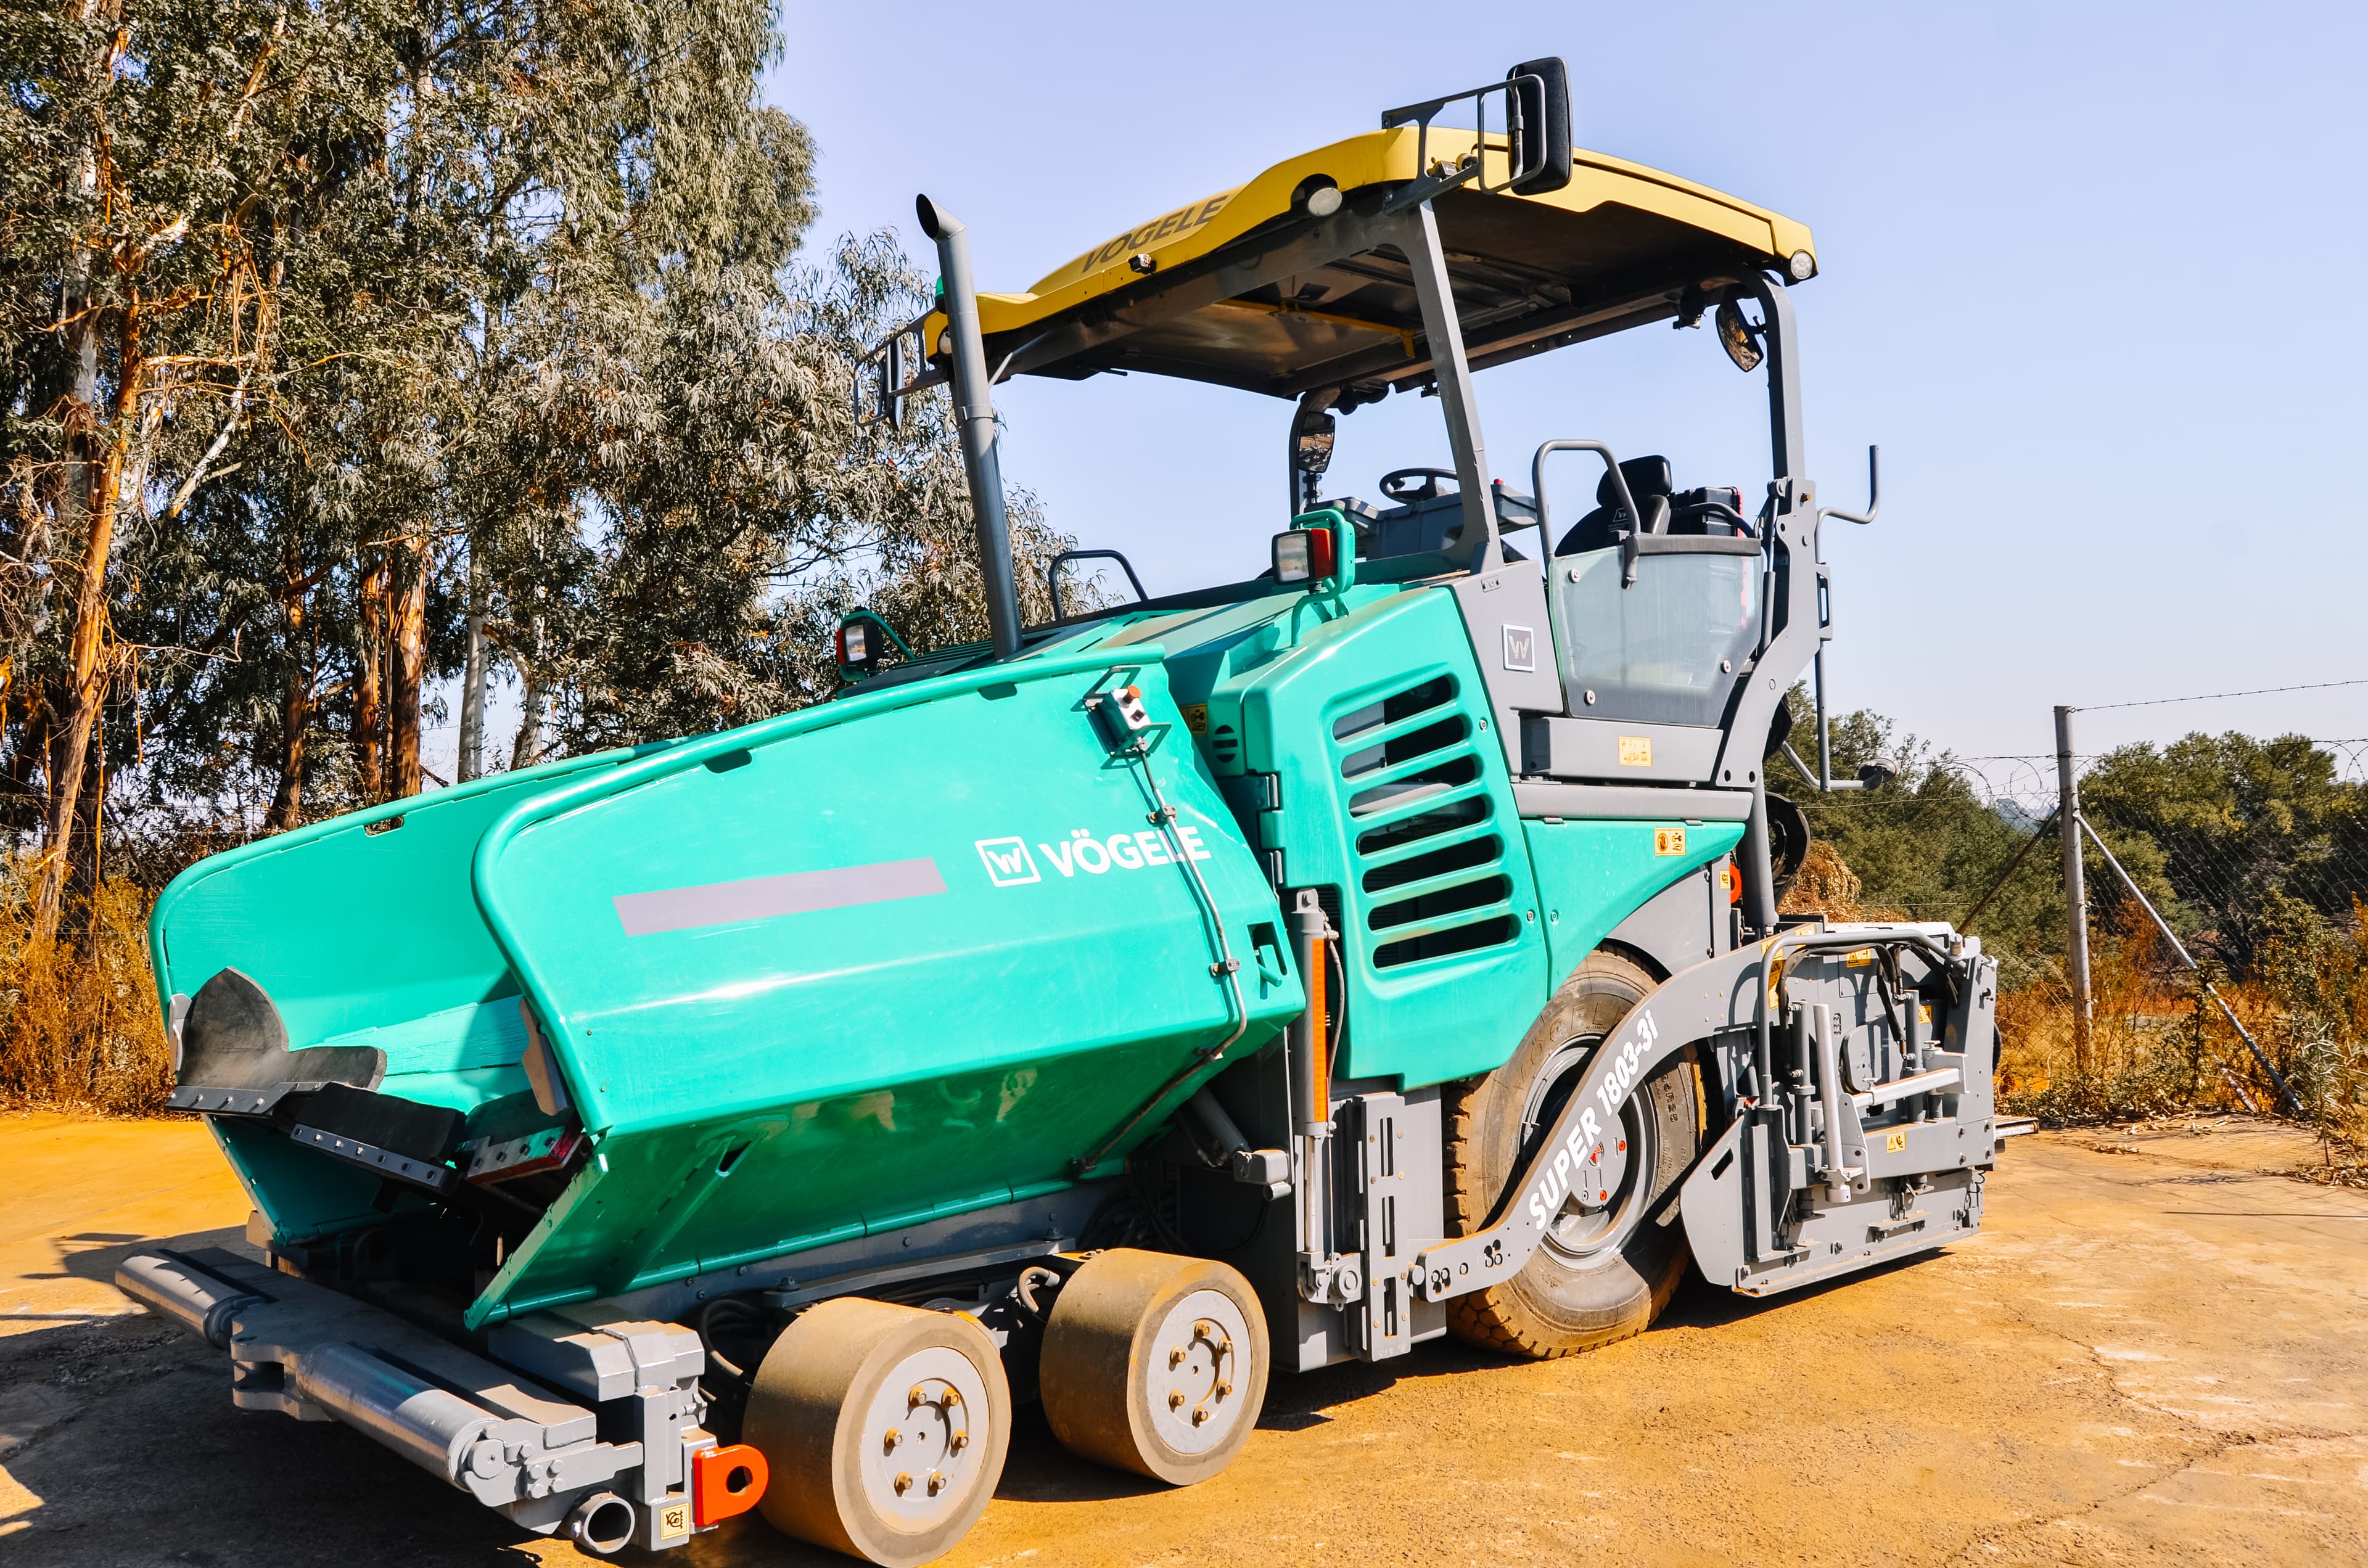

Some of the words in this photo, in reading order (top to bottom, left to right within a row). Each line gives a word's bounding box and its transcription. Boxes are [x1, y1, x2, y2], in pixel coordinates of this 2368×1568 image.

[1038, 826, 1212, 877] VÖGELE
[1529, 1106, 1603, 1231] SUPER
[1596, 1009, 1659, 1117] 1803-3i
